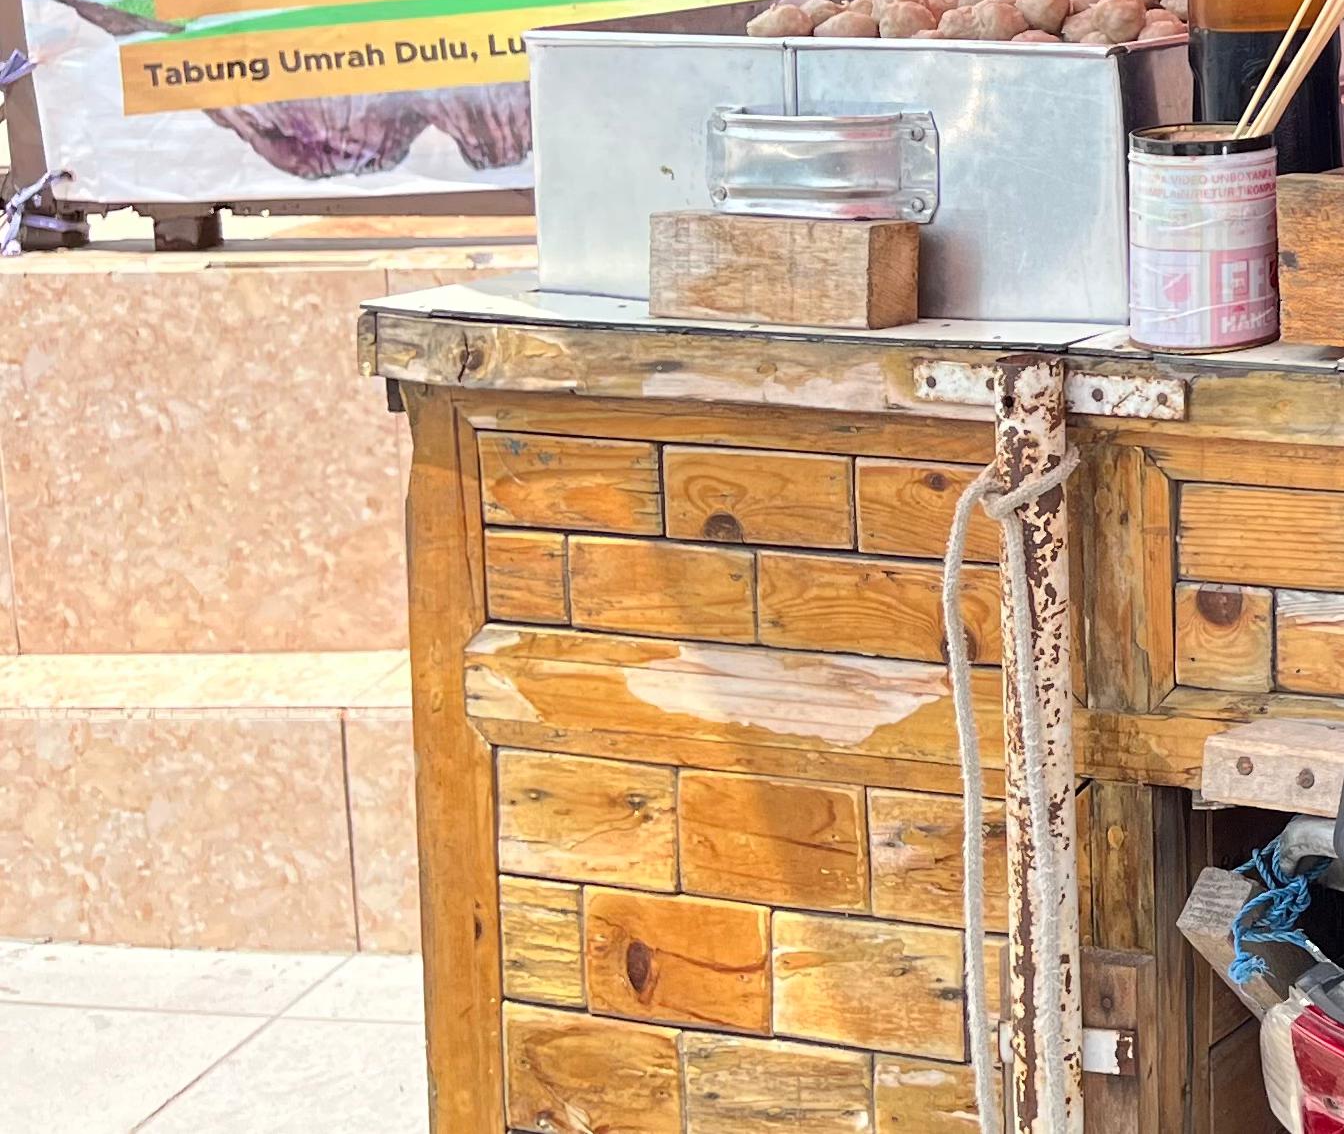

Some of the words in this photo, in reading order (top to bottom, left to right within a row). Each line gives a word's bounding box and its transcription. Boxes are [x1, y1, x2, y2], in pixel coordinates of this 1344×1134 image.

[144, 54, 270, 87] Tabung
[278, 43, 385, 73] Umrah
[395, 36, 478, 64] Dulu,
[488, 34, 526, 56] Lu
